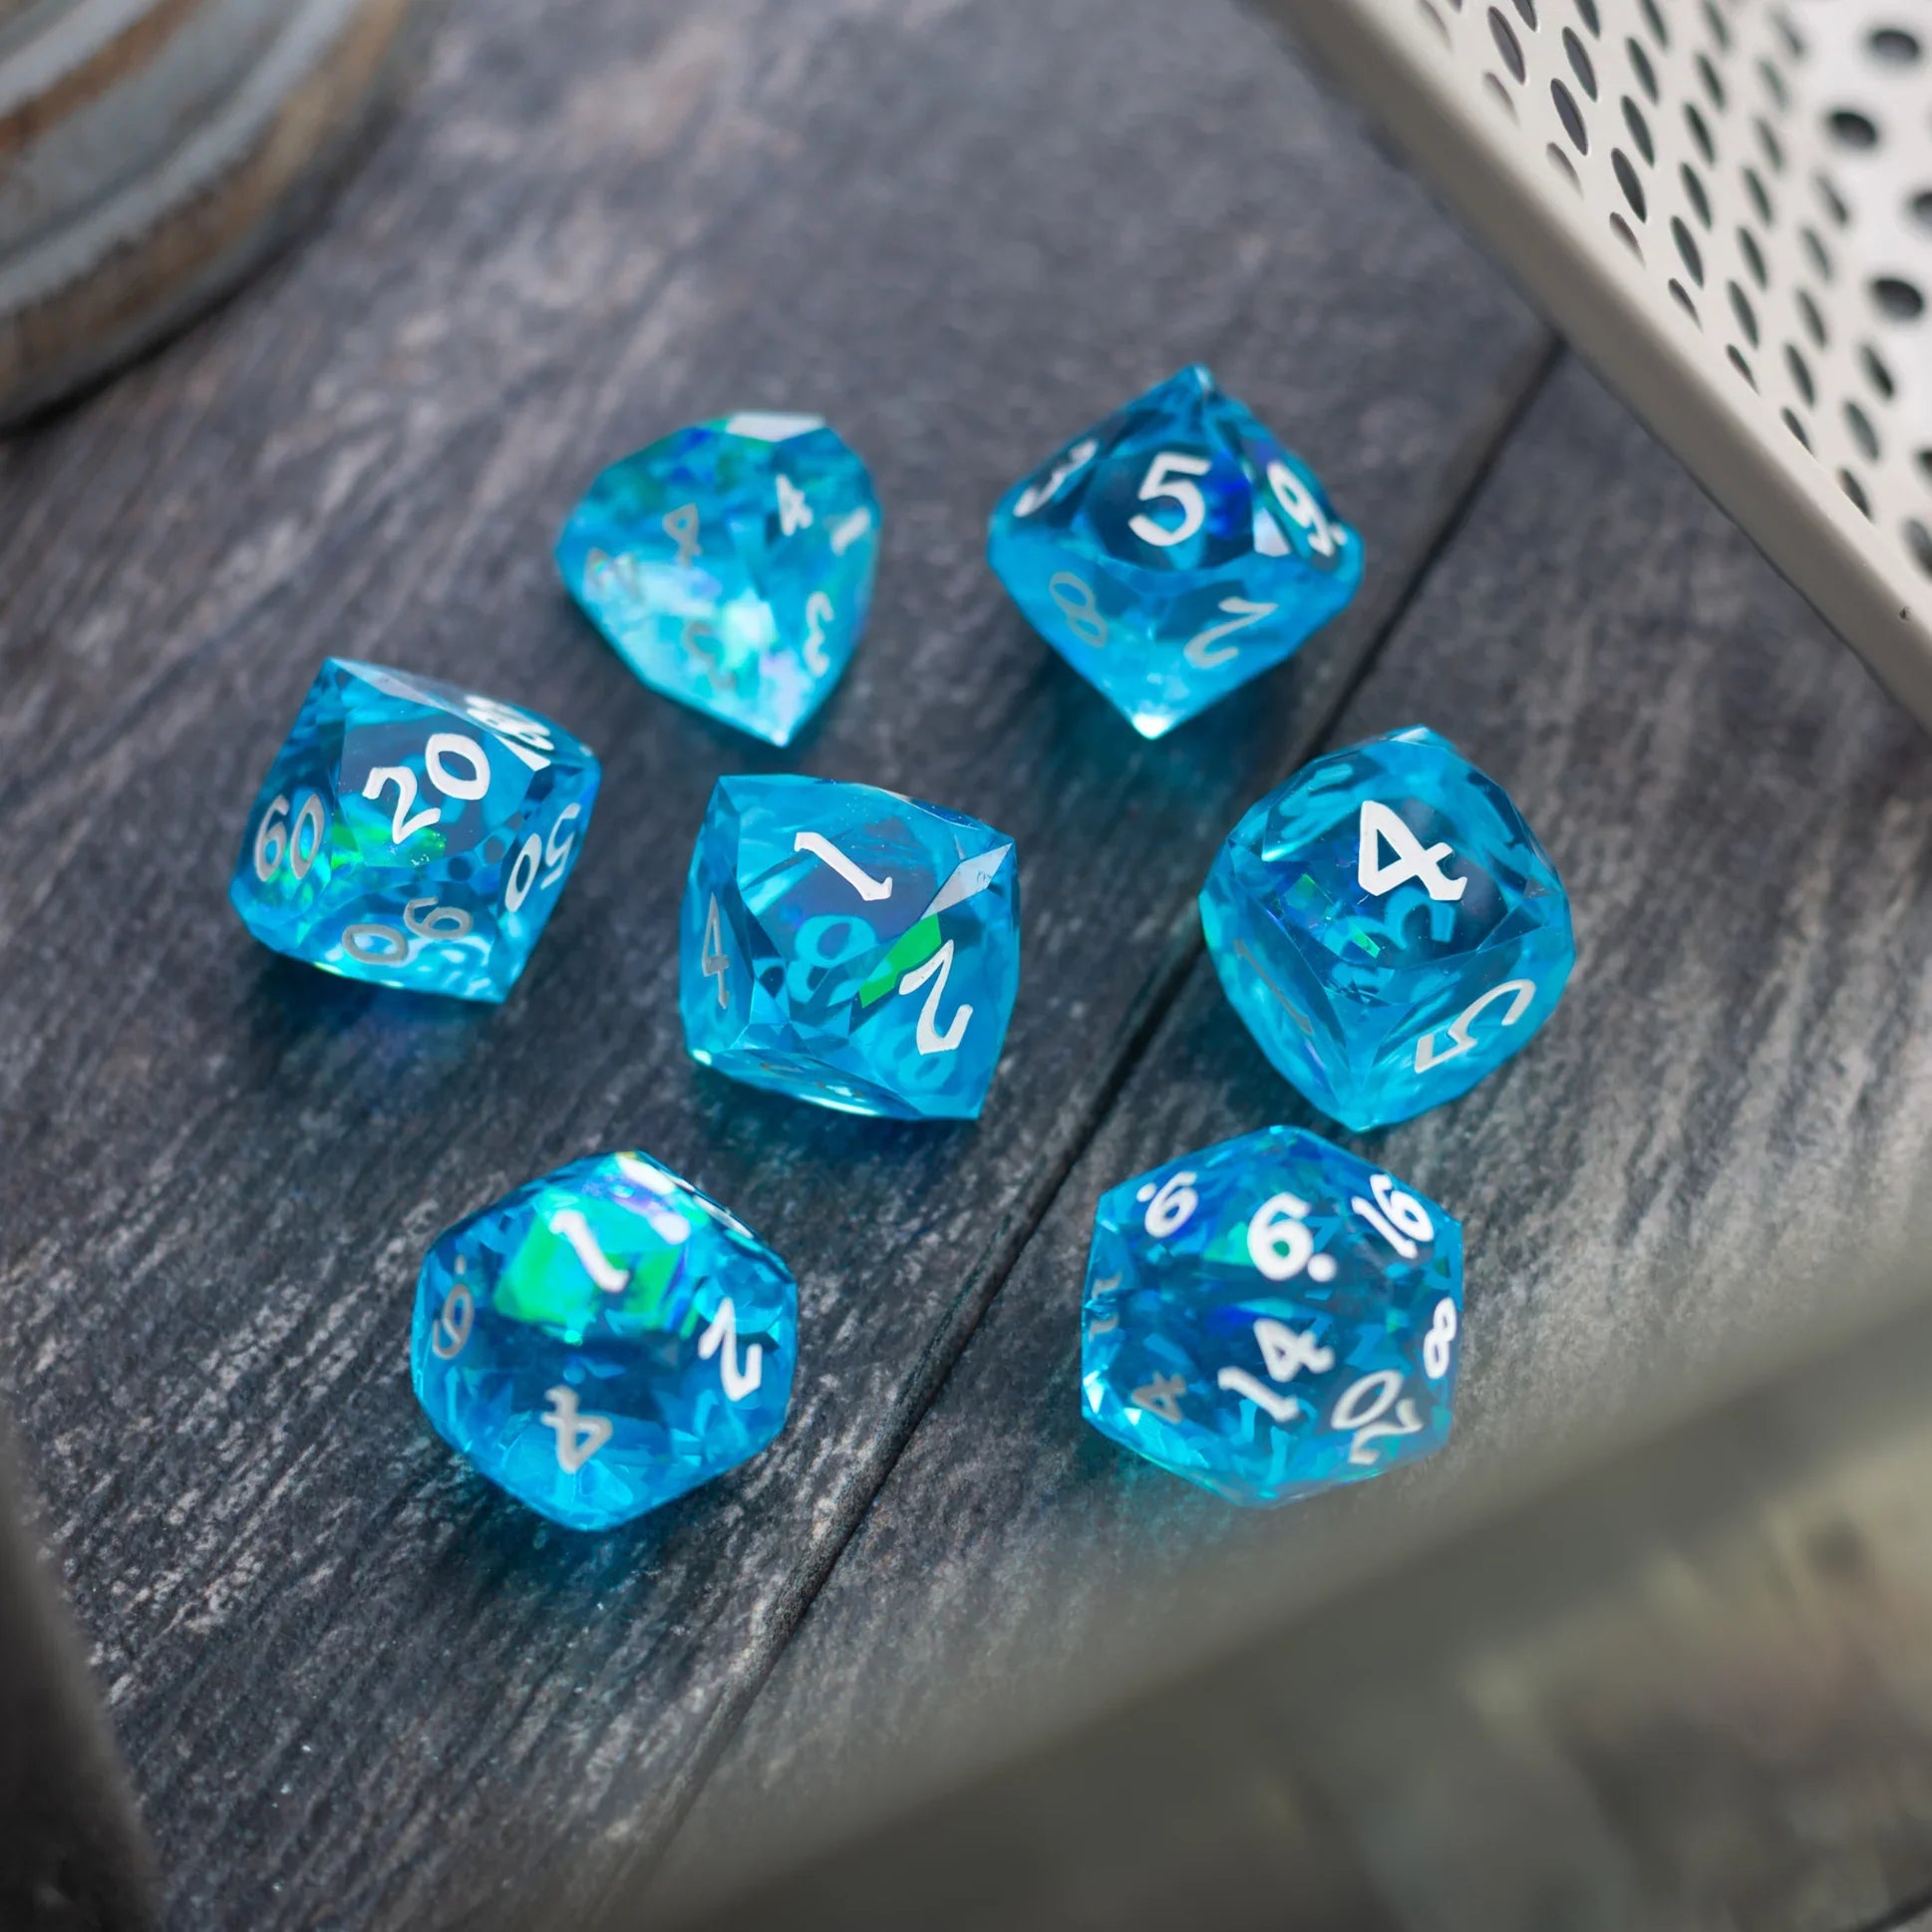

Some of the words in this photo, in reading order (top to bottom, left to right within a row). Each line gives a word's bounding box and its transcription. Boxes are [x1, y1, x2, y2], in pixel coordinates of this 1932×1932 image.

[1127, 452, 1212, 547] 5
[1049, 571, 1109, 648] 8
[1182, 596, 1279, 669] 2
[361, 733, 490, 844] 20
[254, 794, 326, 883] 60
[504, 803, 582, 912] 50
[794, 831, 892, 901] 1
[1358, 801, 1468, 901] 4
[702, 891, 731, 1010] 4
[898, 939, 974, 1056] 2
[1414, 979, 1536, 1074] 5
[549, 1209, 629, 1293] 1
[1351, 1173, 1435, 1259] 16
[699, 1297, 763, 1402] 2
[1217, 1318, 1335, 1423] 14
[1423, 1297, 1457, 1379] 8
[540, 1385, 613, 1473] 4
